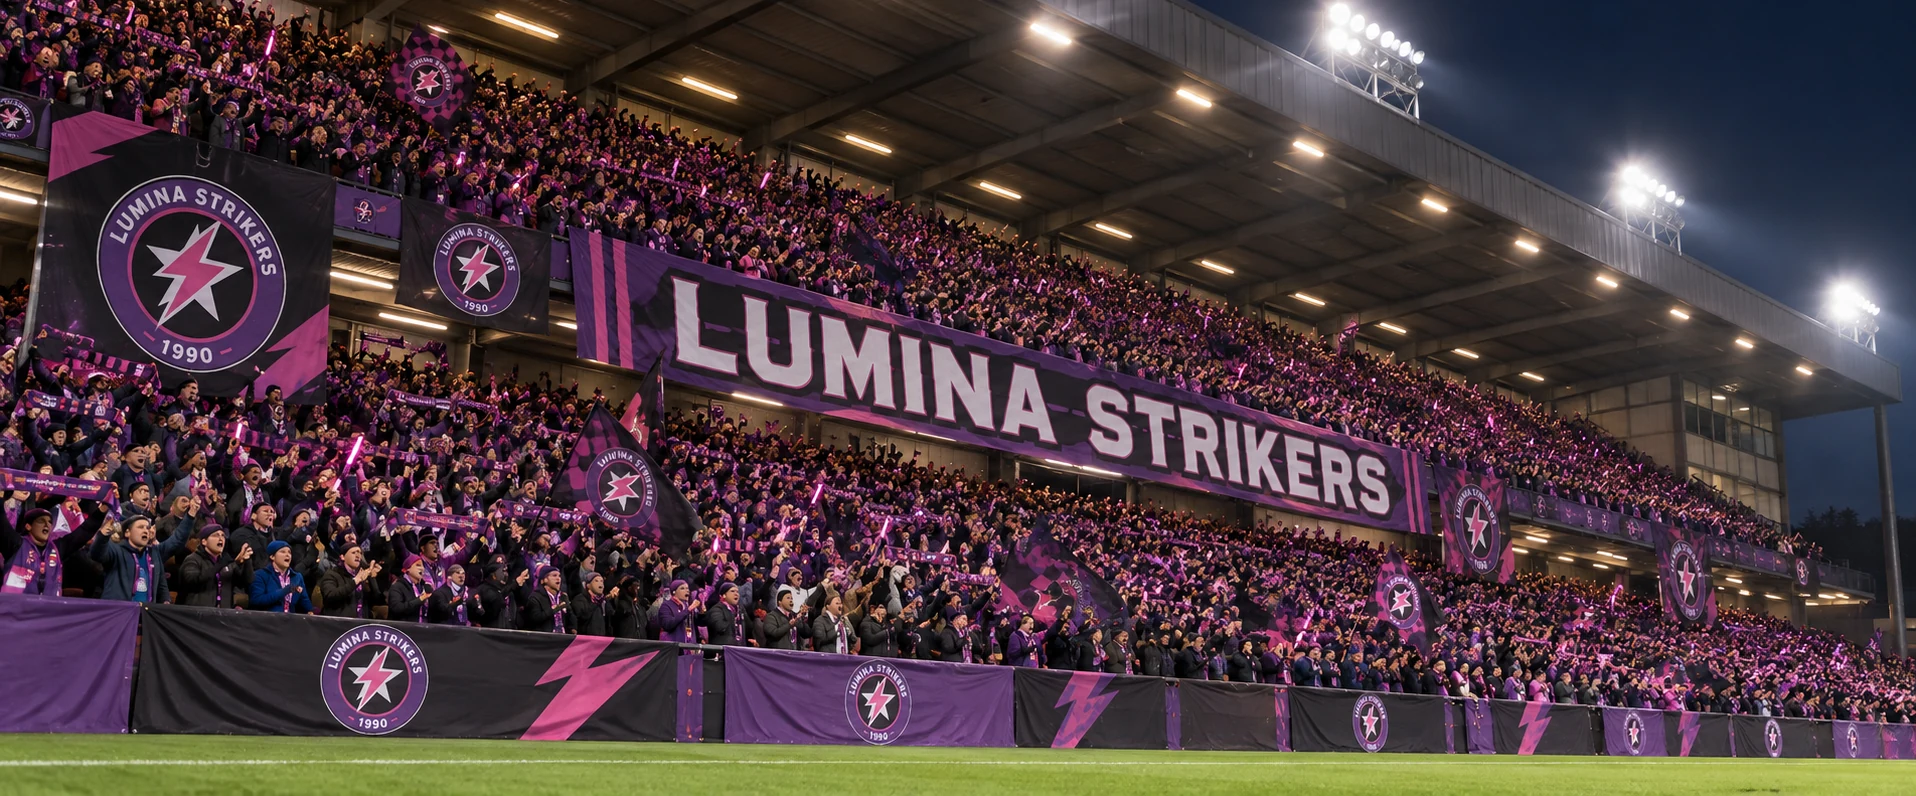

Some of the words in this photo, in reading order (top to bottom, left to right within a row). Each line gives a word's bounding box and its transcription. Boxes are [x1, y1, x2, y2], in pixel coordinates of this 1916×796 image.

[110, 185, 187, 244] LUMINA
[195, 188, 277, 276] STRIKERS
[440, 227, 474, 256] LUMINA
[464, 300, 489, 313] 1990
[161, 339, 213, 363] 1990
[671, 276, 1059, 445] LUMINA
[1086, 383, 1391, 516] STRIKERS
[328, 630, 370, 669] LUMINA
[374, 629, 423, 674] STRIKERS
[358, 717, 388, 729] 1990
